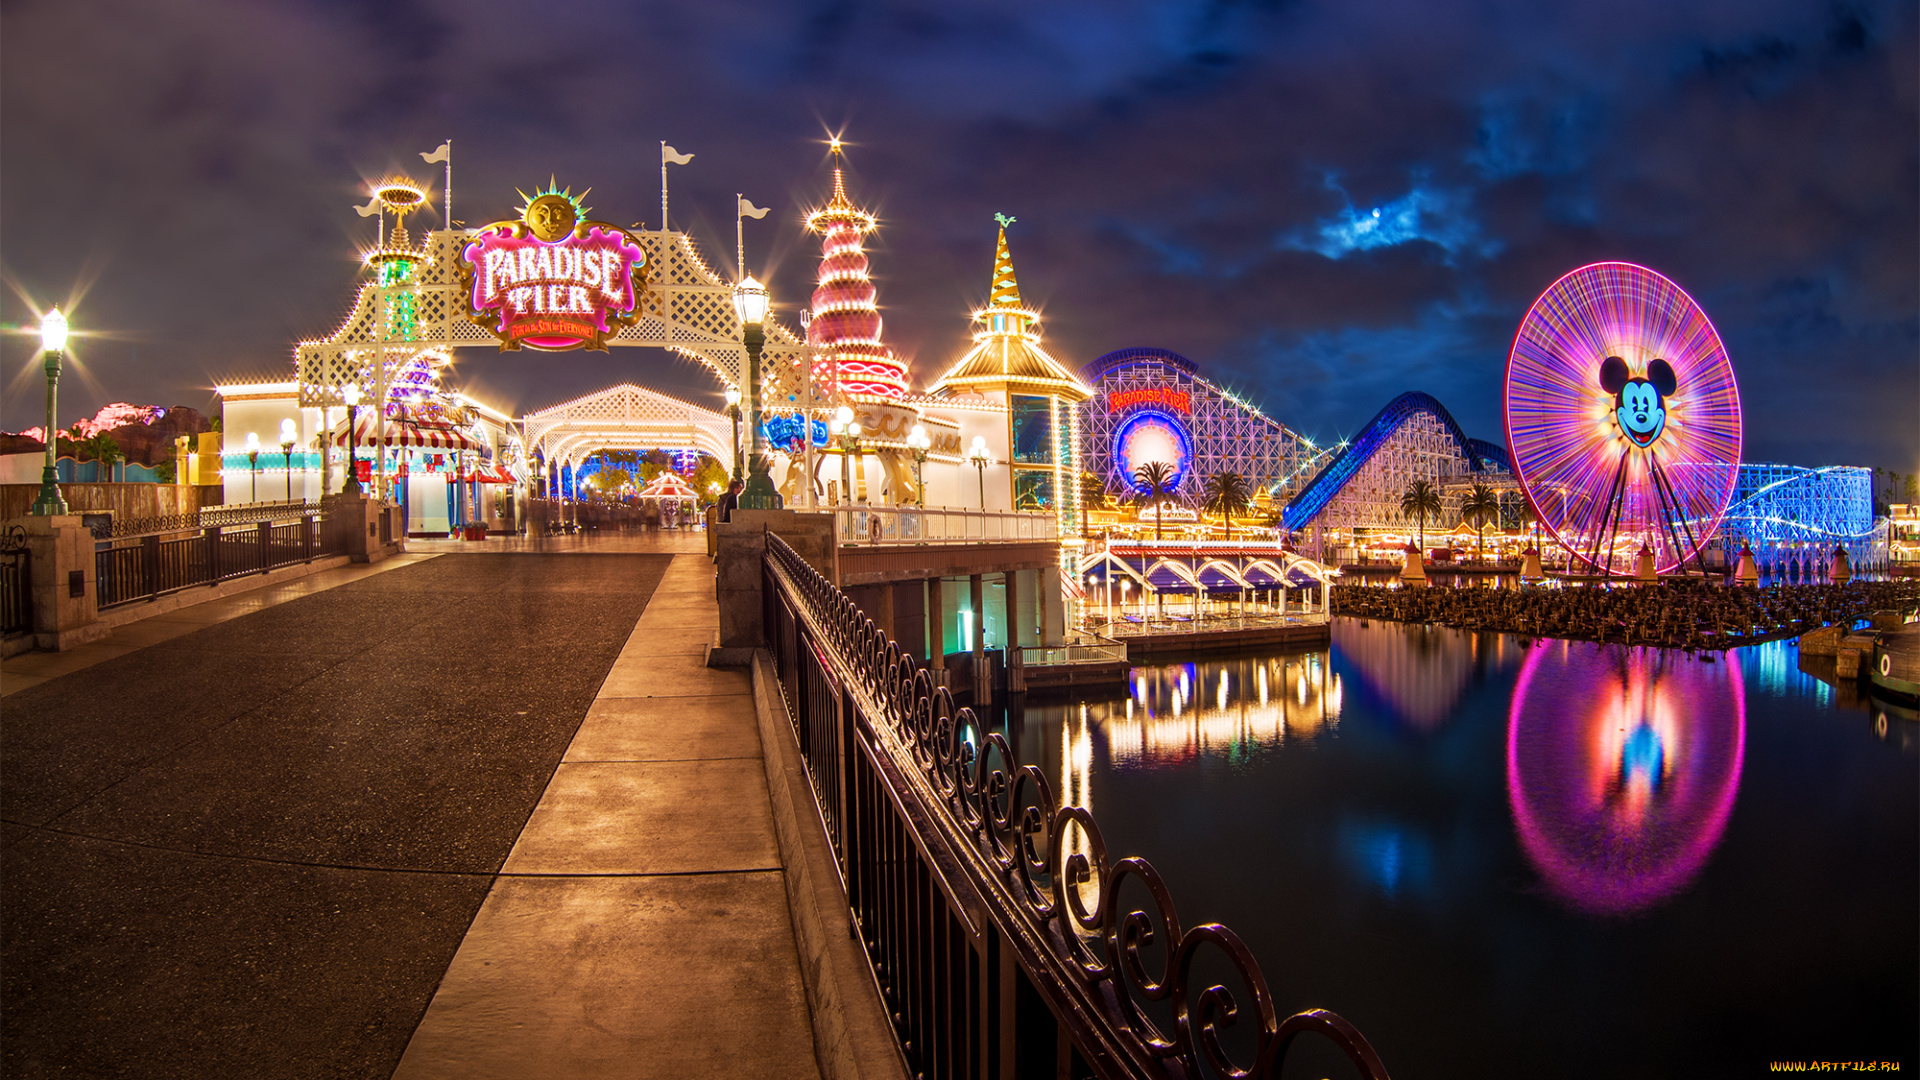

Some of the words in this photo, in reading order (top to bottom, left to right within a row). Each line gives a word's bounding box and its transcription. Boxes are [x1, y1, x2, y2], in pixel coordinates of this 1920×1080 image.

[484, 246, 624, 302] PARADISE
[508, 285, 595, 315] PIER
[511, 324, 526, 339] FUN
[538, 319, 553, 334] SUN
[1109, 389, 1161, 415] PARADISE
[1162, 387, 1191, 415] PIER
